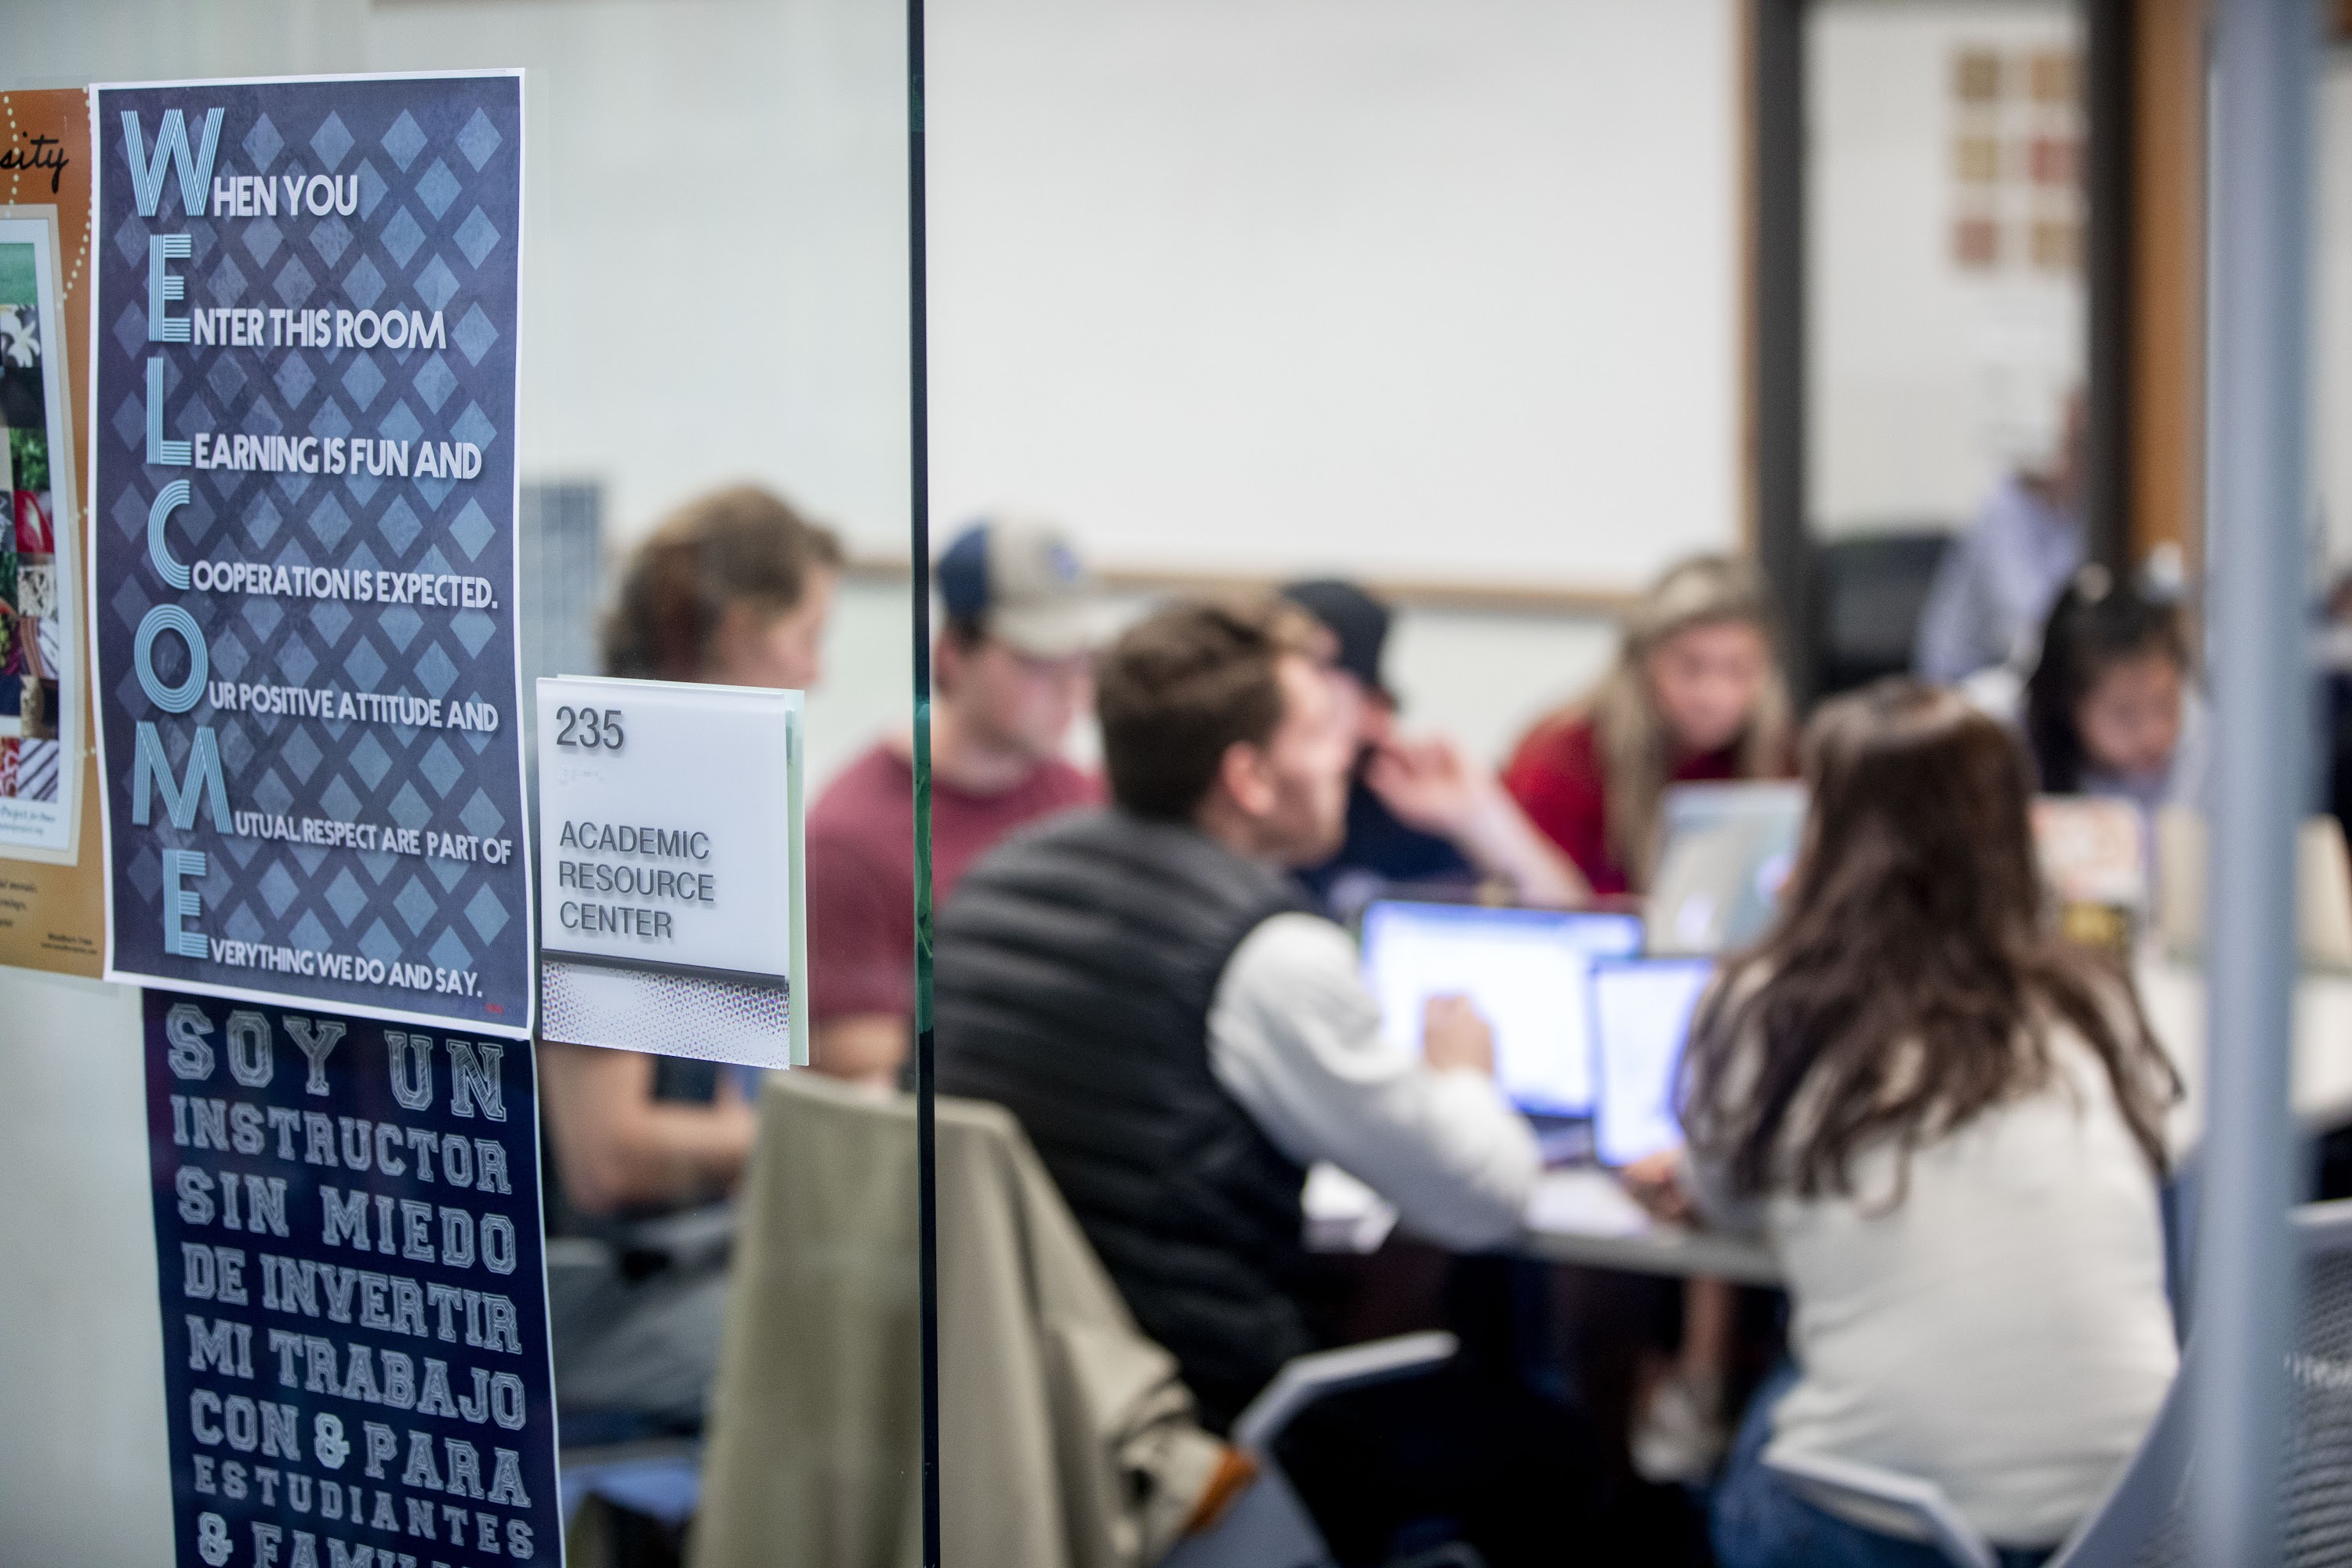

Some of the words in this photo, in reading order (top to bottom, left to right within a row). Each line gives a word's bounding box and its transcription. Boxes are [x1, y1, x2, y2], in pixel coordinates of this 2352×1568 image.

[283, 175, 358, 216] YOU
[269, 308, 331, 347] THIS
[336, 310, 447, 349] ROOM
[323, 436, 345, 474] IS
[351, 438, 408, 477] FUN
[414, 441, 482, 480] AND
[354, 570, 373, 602] IS
[376, 572, 498, 609] EXPECTED.
[239, 684, 335, 718] POSITIVE
[338, 691, 442, 728] ATTITUDE
[447, 701, 499, 732] AND
[555, 706, 624, 750] 235
[302, 818, 376, 851] RESPECT
[382, 826, 420, 855] ARE
[426, 831, 479, 862] PART
[482, 837, 513, 865] OF
[559, 820, 710, 860] ACADEMIC
[559, 861, 715, 902] RESOURCE
[560, 901, 673, 939] CENTER
[317, 952, 354, 982] WE
[354, 956, 385, 985] DO
[388, 960, 433, 990] AND
[436, 968, 482, 998] SAY.
[165, 1003, 347, 1097] SOY
[383, 1029, 506, 1122] UN
[170, 1094, 513, 1195] INSTRUCTOR
[175, 1164, 289, 1238] SIN
[318, 1184, 517, 1276] MIEDO
[181, 1241, 249, 1306] DE
[259, 1253, 522, 1355] INVERTIR
[184, 1314, 254, 1380] MI
[268, 1328, 526, 1431] TRABAJO
[189, 1388, 302, 1462] CON
[314, 1412, 350, 1470] &
[363, 1420, 532, 1508] PARA
[192, 1454, 535, 1560] ESTUDIANTES
[197, 1512, 234, 1568] &
